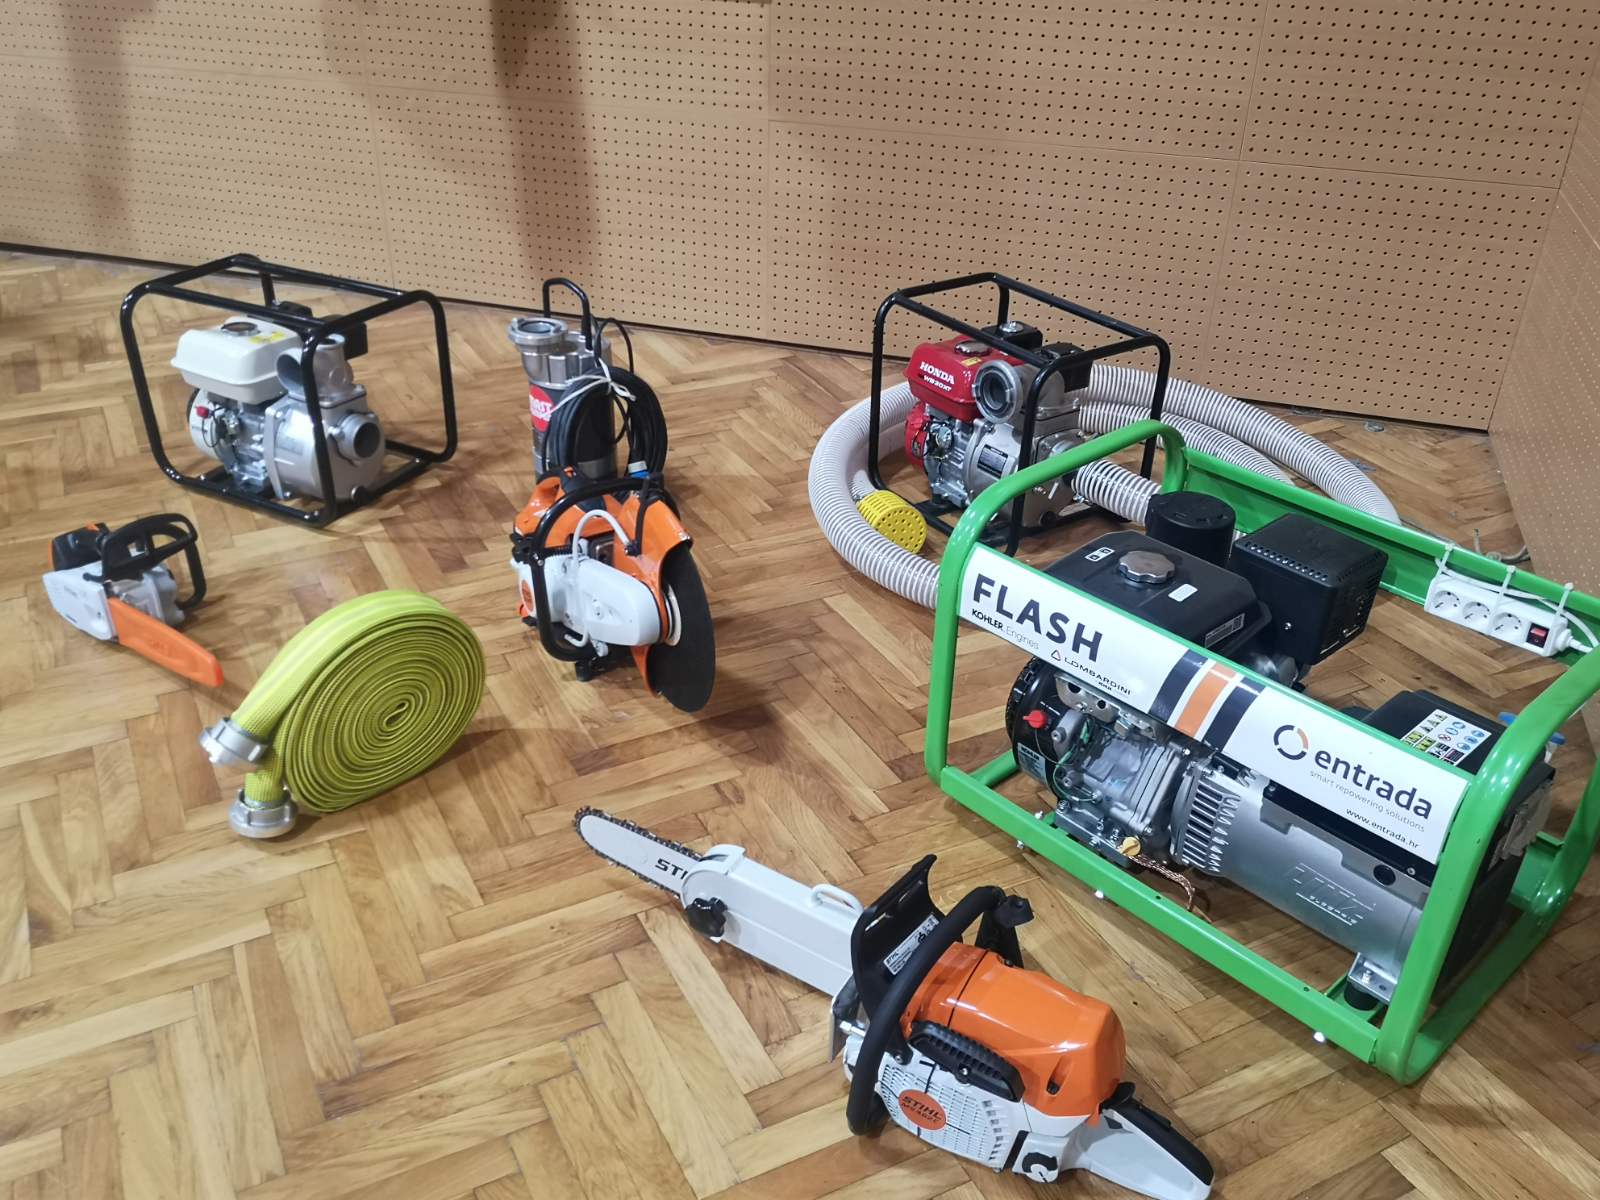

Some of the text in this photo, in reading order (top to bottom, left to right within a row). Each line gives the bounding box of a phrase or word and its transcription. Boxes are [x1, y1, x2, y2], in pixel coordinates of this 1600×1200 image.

[920, 361, 955, 385] HONDA
[972, 608, 1004, 630] KOHLER
[973, 573, 1103, 663] FLASH
[1064, 657, 1132, 696] LOMBARDINI
[1310, 770, 1425, 833] smart repowering solutions
[1314, 750, 1433, 820] entrada
[1346, 808, 1420, 849] www.entrada.hr
[655, 858, 688, 880] STI
[902, 1096, 943, 1121] STIHL
